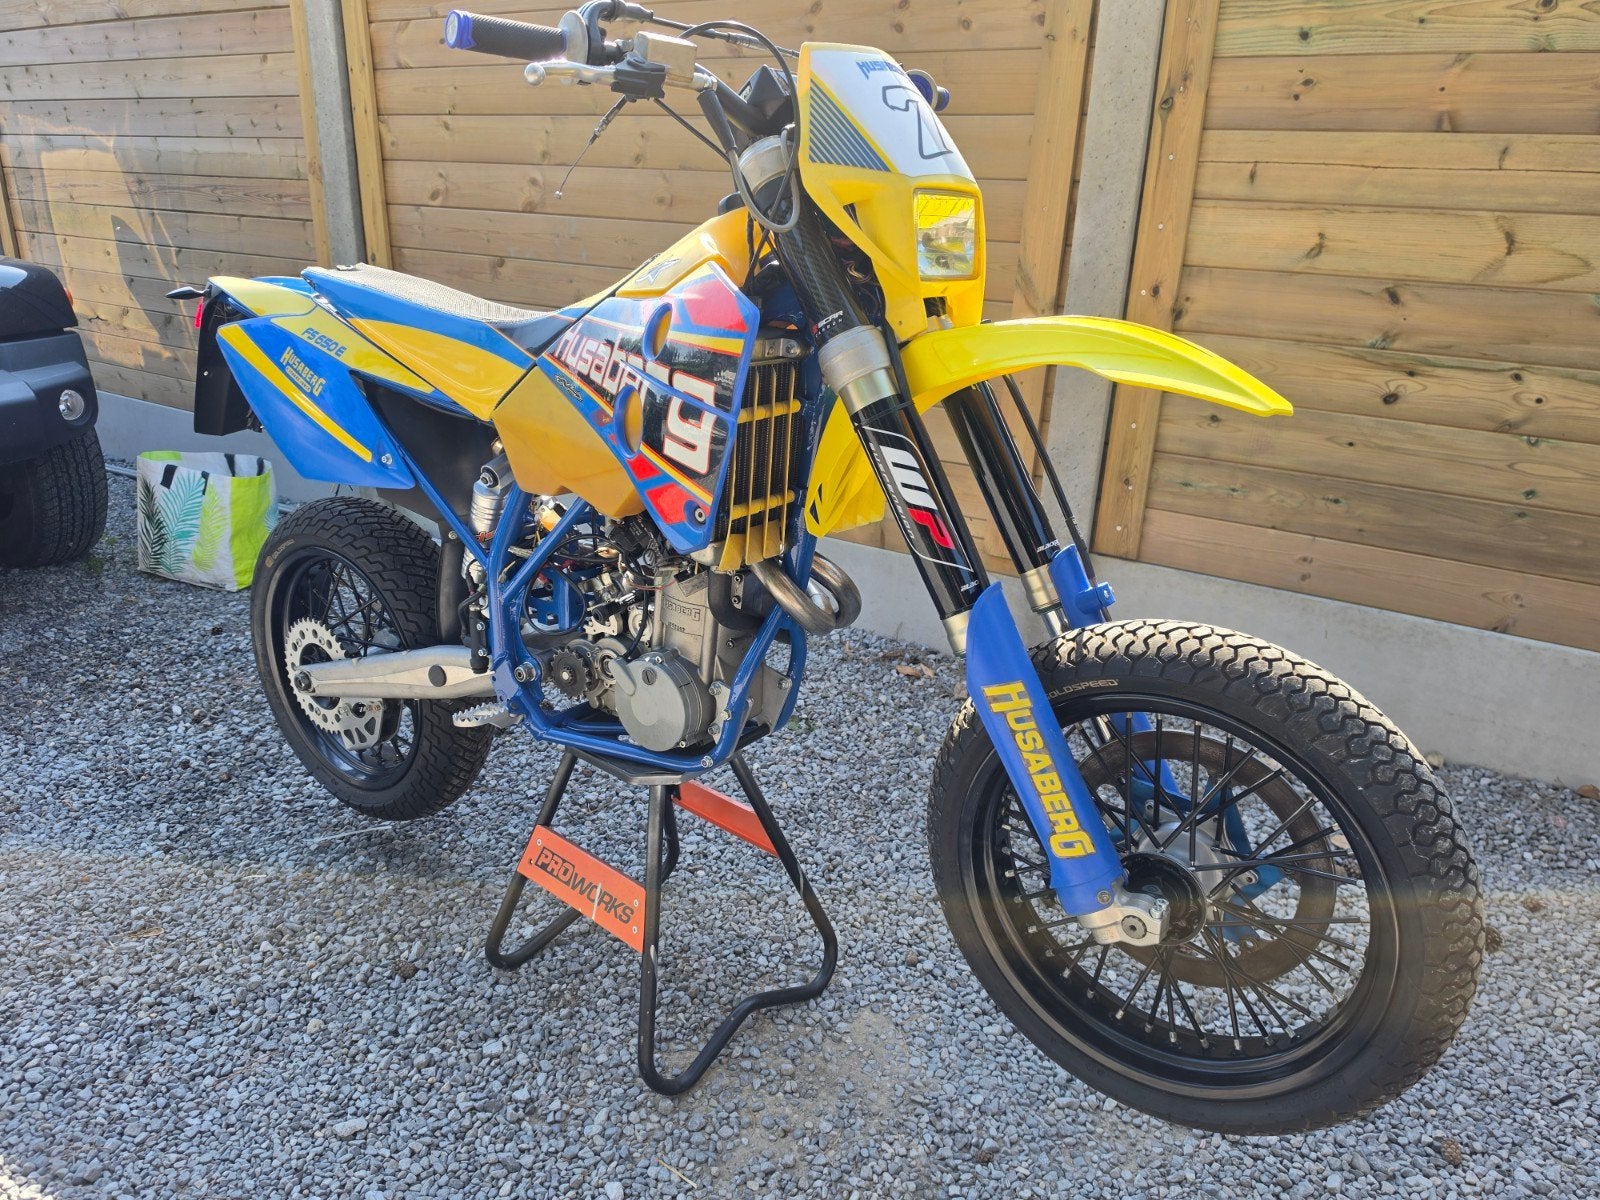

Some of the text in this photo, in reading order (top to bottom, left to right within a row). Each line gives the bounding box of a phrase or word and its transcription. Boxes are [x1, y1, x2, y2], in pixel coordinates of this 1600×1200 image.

[280, 346, 326, 397] HUSABERG
[879, 445, 955, 549] WP
[980, 680, 1097, 860] HUSABERG
